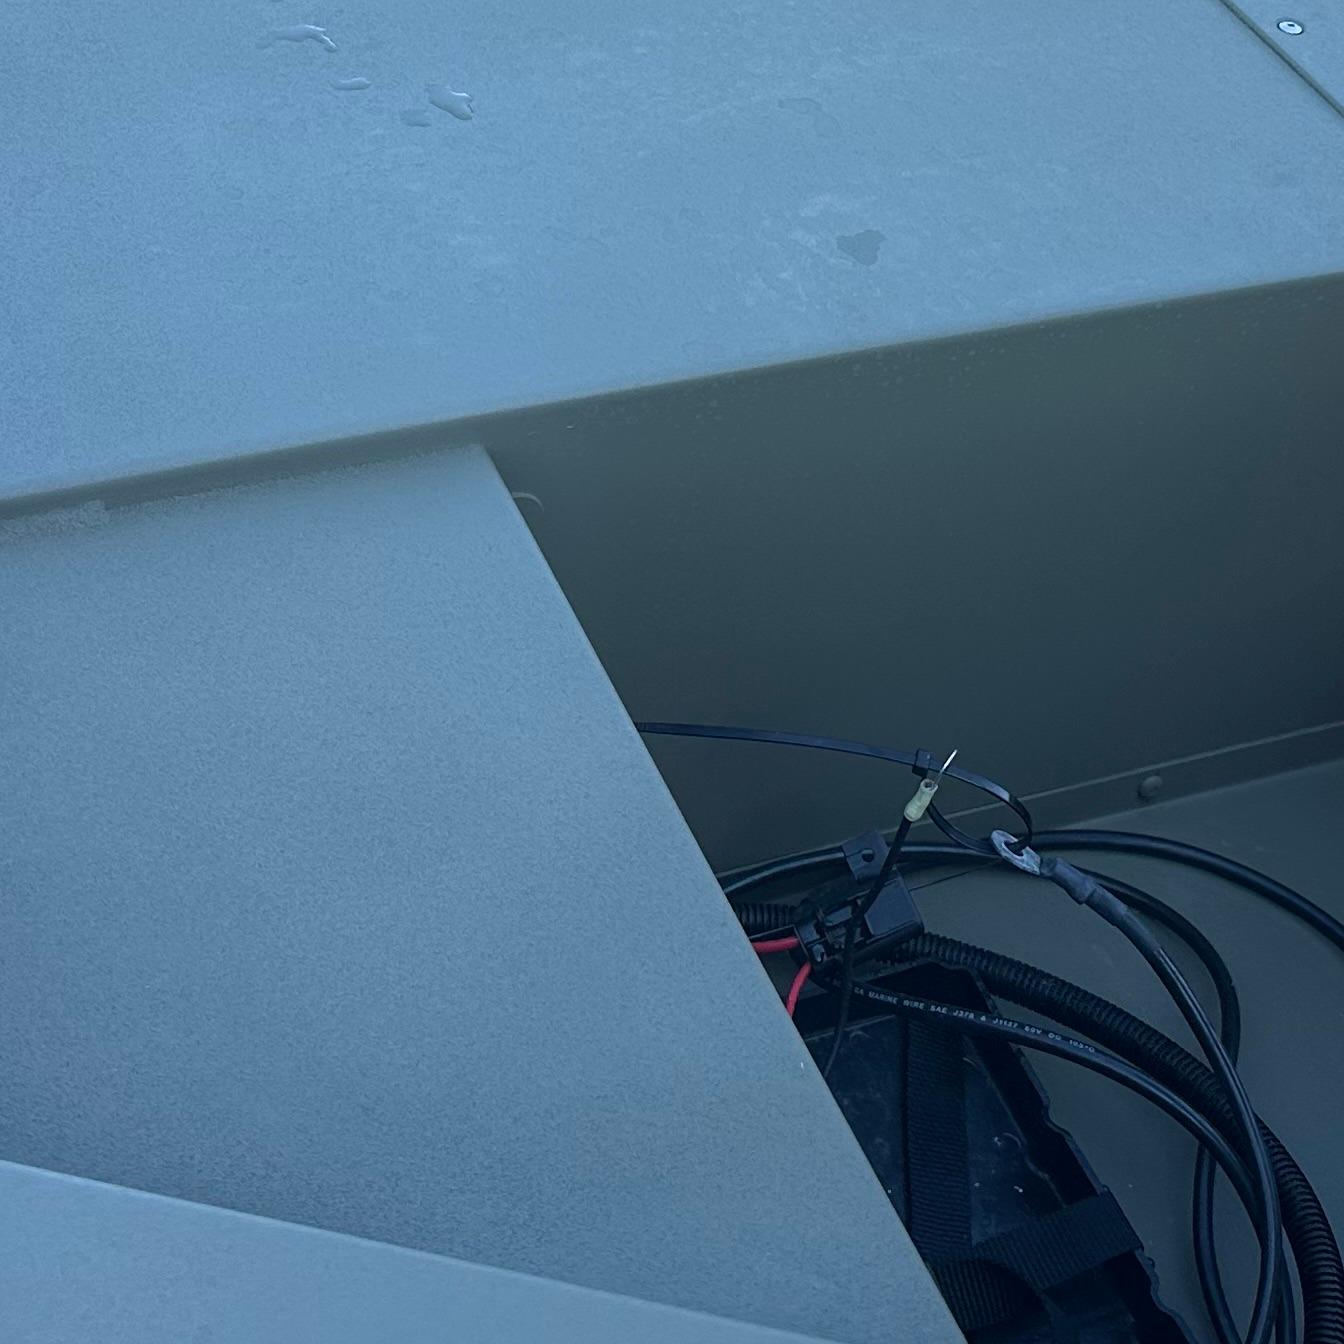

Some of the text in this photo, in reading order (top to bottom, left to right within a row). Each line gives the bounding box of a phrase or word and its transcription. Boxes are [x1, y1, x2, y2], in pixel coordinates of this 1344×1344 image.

[868, 991, 898, 1004] MARINE
[903, 999, 925, 1010] WIRE
[930, 1004, 948, 1015] SAE
